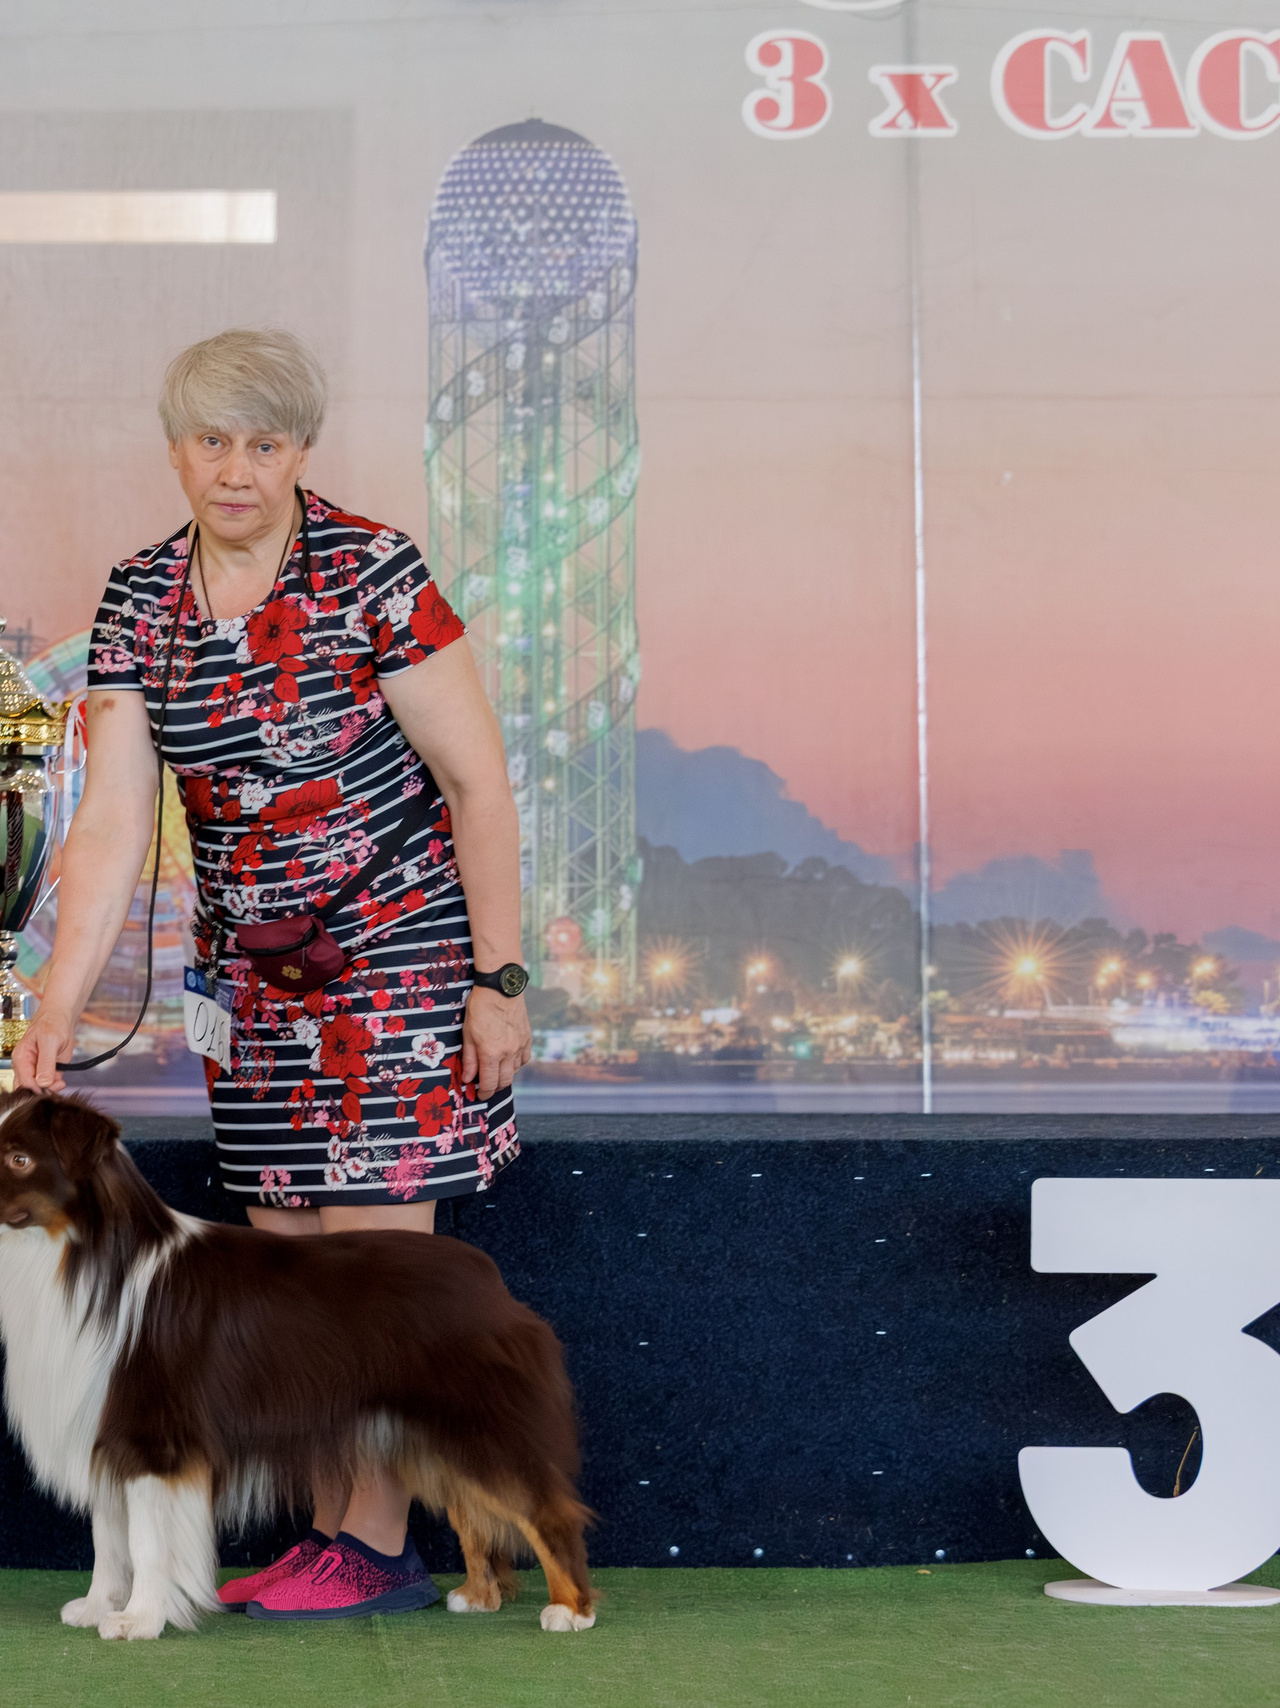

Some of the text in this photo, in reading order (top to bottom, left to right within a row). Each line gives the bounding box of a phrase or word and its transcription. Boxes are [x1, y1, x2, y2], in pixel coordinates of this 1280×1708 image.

[742, 28, 1280, 140] 3 x CAC
[1018, 1177, 1280, 1591] 3
